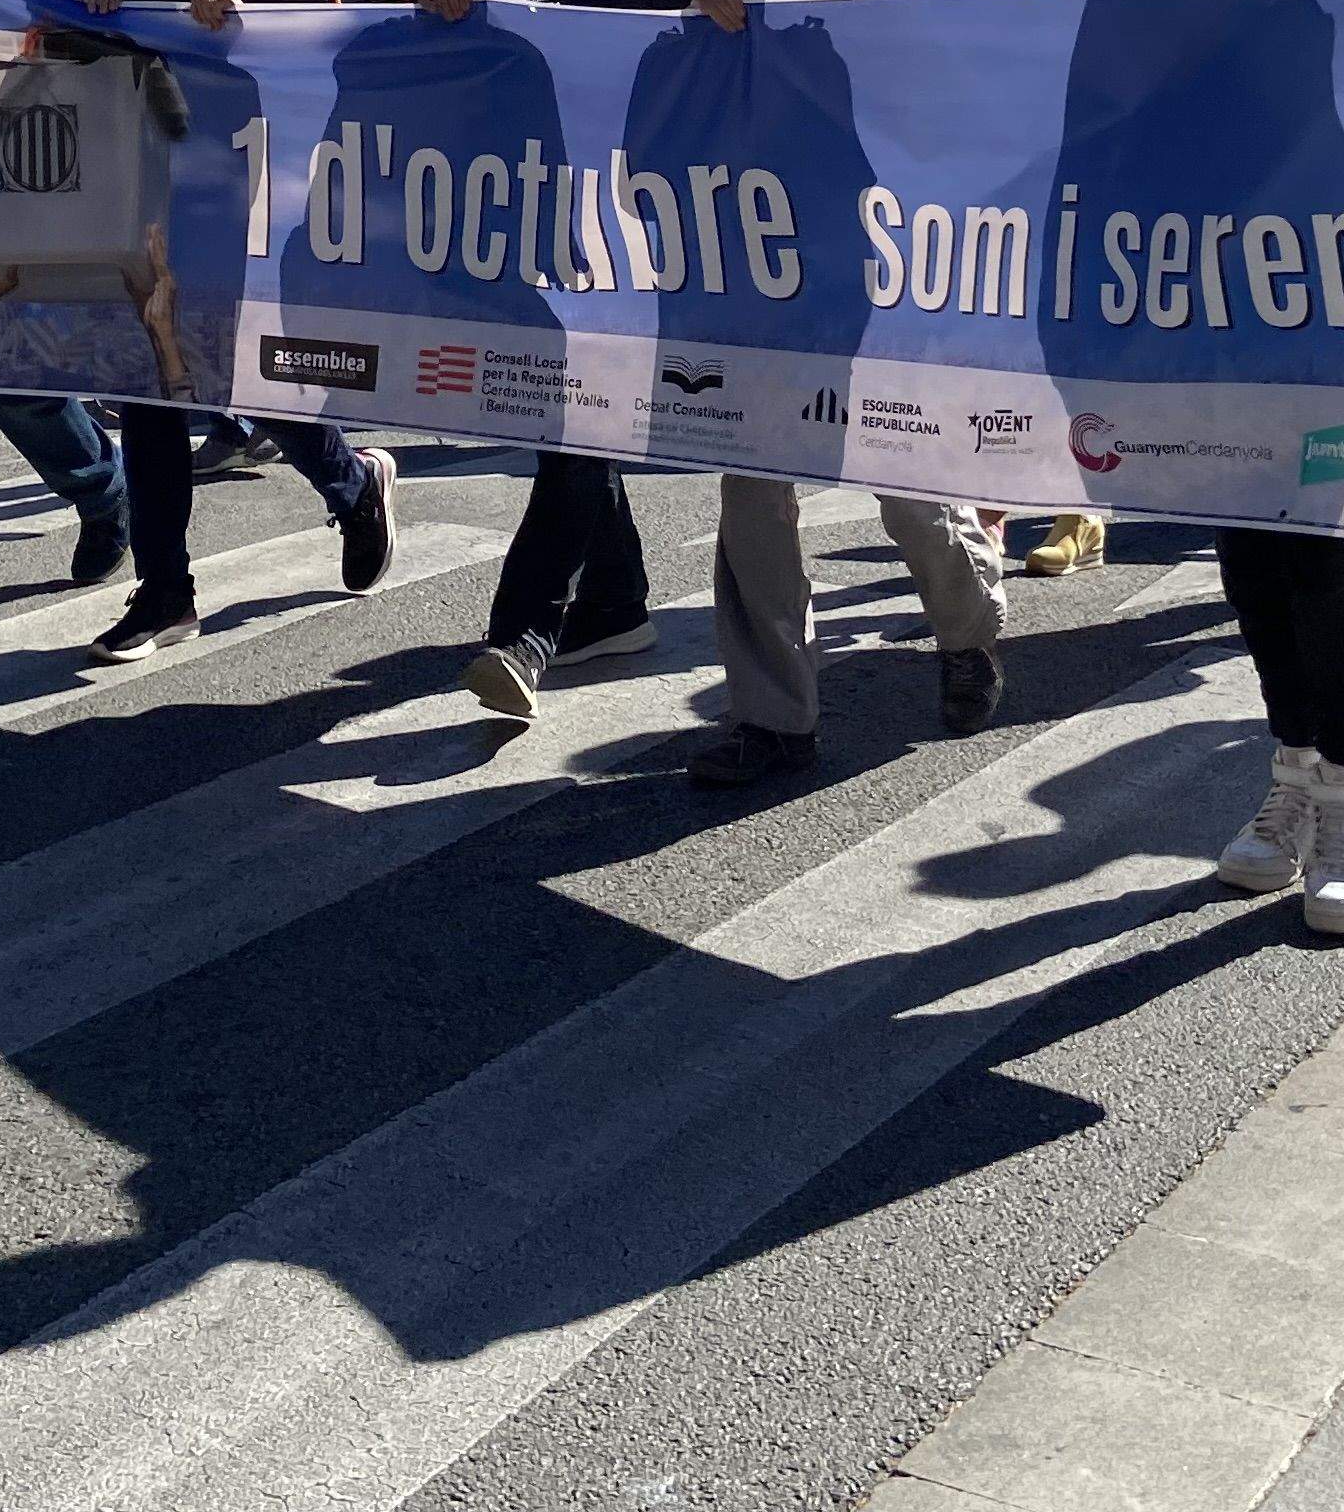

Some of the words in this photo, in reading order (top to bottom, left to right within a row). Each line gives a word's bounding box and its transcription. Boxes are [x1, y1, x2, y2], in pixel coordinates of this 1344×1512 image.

[232, 117, 268, 256] 1
[308, 121, 802, 300] d'octubre
[1056, 183, 1079, 320] i
[273, 349, 366, 373] assemblea
[484, 350, 532, 367] Consell
[534, 355, 568, 370] Local
[482, 369, 503, 382] per
[506, 369, 518, 382] la
[481, 383, 551, 402] Cerdanyola
[553, 388, 573, 405] del
[575, 392, 610, 410] Vallès
[486, 399, 546, 418] Bellaterra
[634, 397, 671, 414] Debat
[672, 402, 744, 423] Constituent
[862, 399, 923, 417] ESQUERRA
[860, 416, 942, 436] REPUBLICANA
